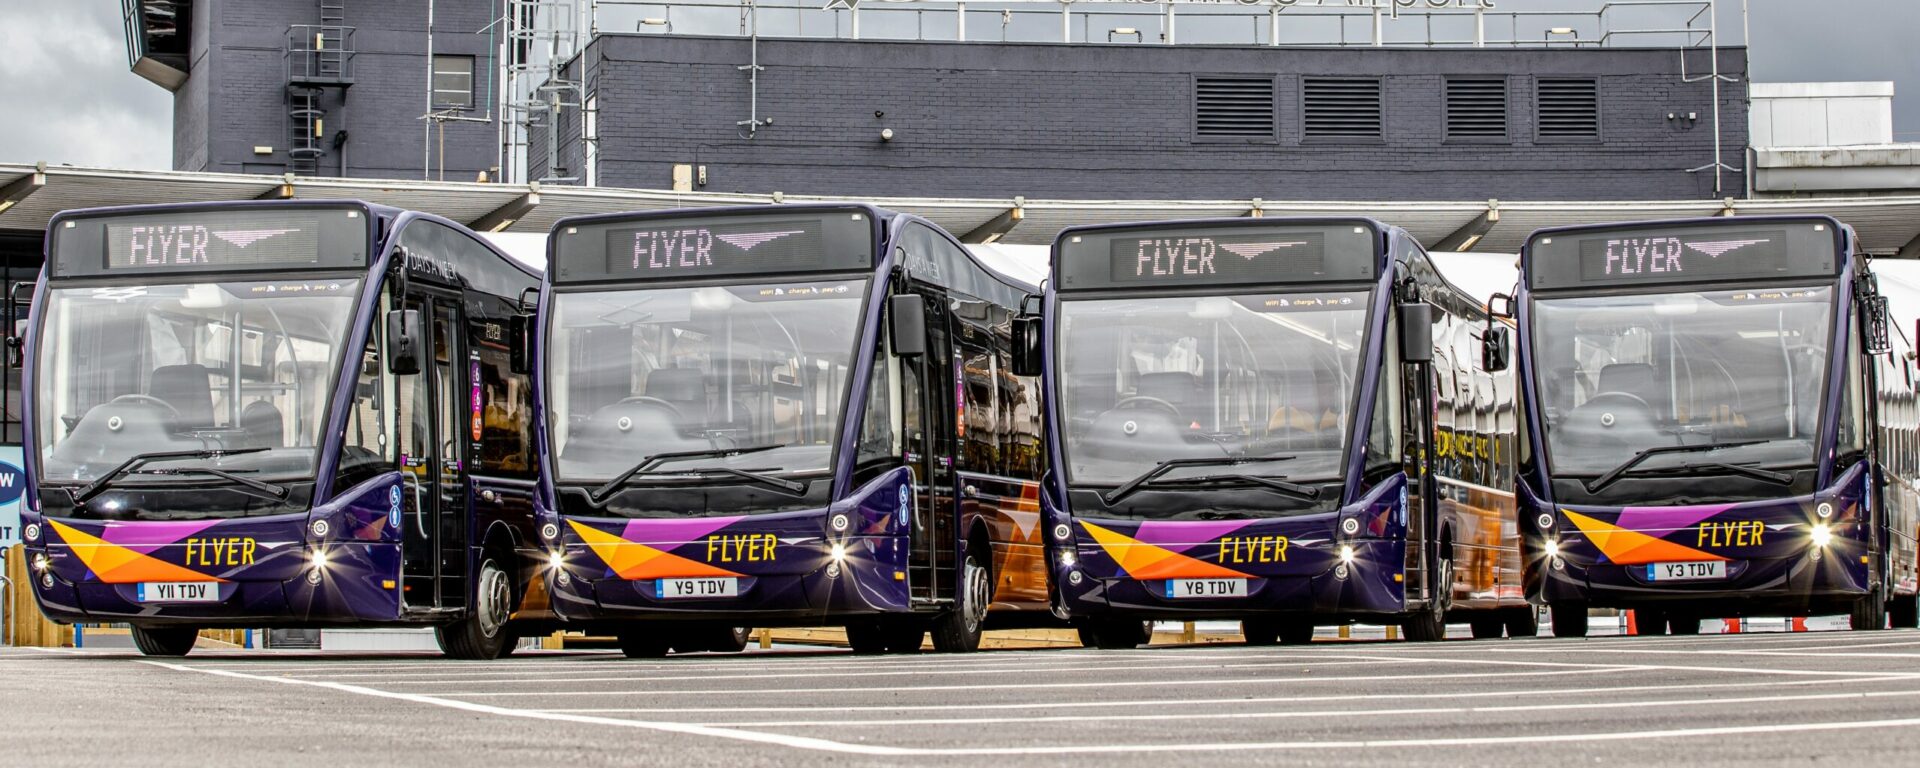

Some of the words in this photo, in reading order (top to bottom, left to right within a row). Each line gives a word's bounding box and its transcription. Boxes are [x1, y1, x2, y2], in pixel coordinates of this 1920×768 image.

[129, 225, 209, 265] FLYER
[633, 229, 713, 269] FLYER
[1136, 238, 1216, 276] FLYER
[1605, 237, 1683, 274] FLYER
[410, 252, 431, 274] DAYS
[431, 257, 438, 277] A
[437, 258, 459, 281] WEEK
[788, 287, 811, 295] charge
[707, 533, 777, 562] FLYER
[1697, 521, 1765, 548] FLYER
[186, 537, 256, 566] FLYER
[1219, 536, 1289, 563] FLYER
[1666, 564, 1684, 577] Y3
[1688, 563, 1715, 577] TDV
[157, 584, 175, 598] Y11
[178, 584, 206, 598] TDV
[675, 581, 694, 594] Y9
[698, 580, 726, 594] TDV
[1185, 581, 1204, 594] Y8
[1208, 581, 1236, 594] TDV
